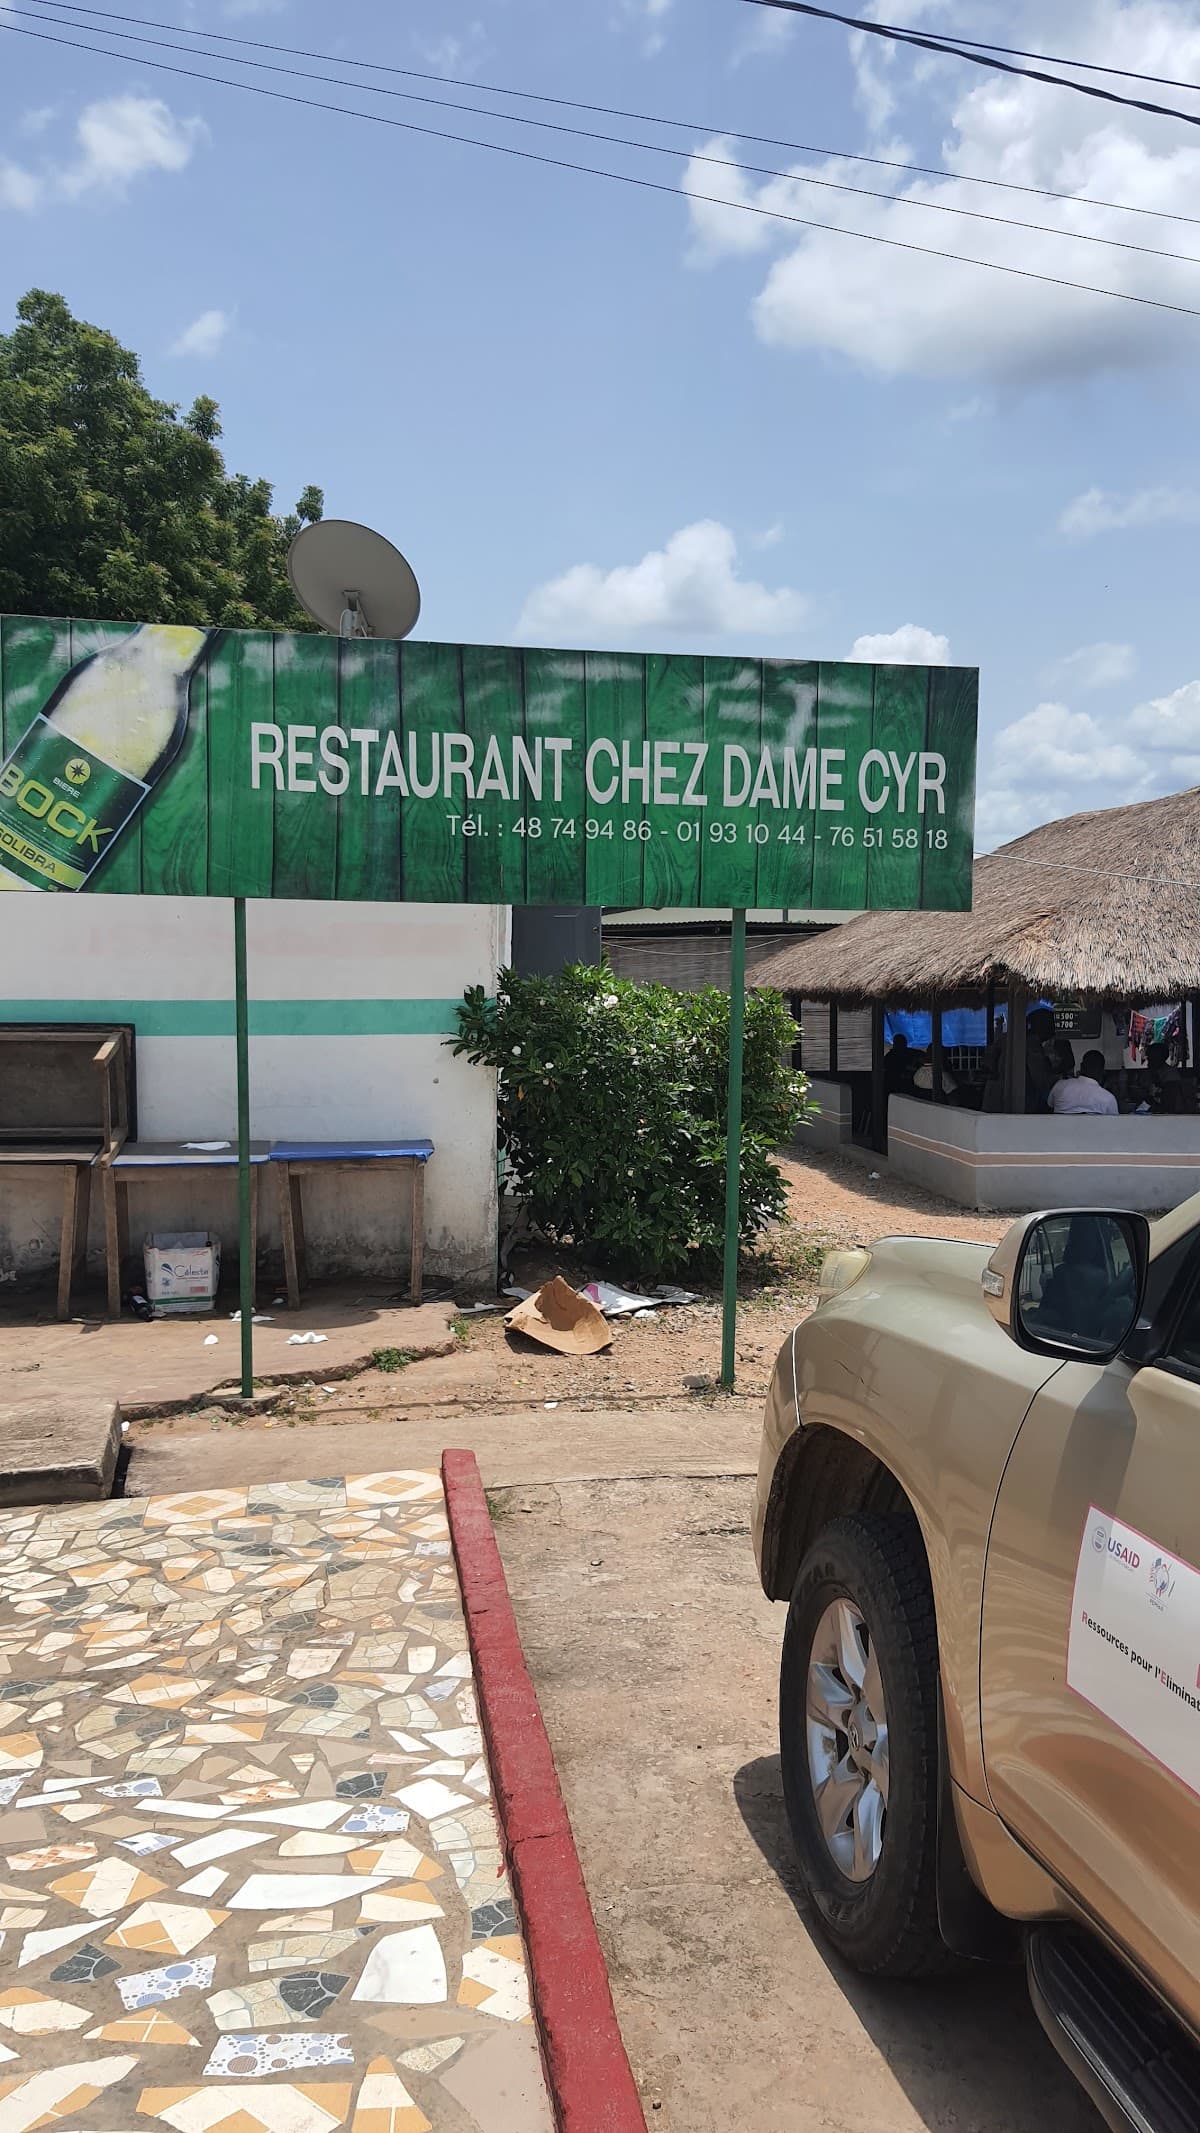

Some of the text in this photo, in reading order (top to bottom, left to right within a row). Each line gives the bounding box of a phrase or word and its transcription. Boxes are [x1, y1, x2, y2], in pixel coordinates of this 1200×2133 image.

[52, 776, 81, 799] BIERE
[250, 721, 946, 814] RESTAURANT CHEZ DAME CYR
[0, 762, 115, 854] BOCK
[446, 813, 489, 837] Tél.
[511, 817, 542, 839] 48
[550, 818, 577, 839] 74
[585, 819, 614, 840] 94
[622, 819, 652, 841] 86
[676, 821, 700, 842] 01
[709, 822, 737, 843] 93
[745, 823, 770, 844] 10
[777, 825, 806, 845] 44
[830, 826, 855, 847] 76
[862, 827, 883, 848] 51
[891, 828, 918, 849] 58
[926, 829, 948, 850] 18
[1107, 1537, 1141, 1569] USAID
[1081, 1610, 1129, 1656] Ressources
[1130, 1650, 1153, 1673] pour
